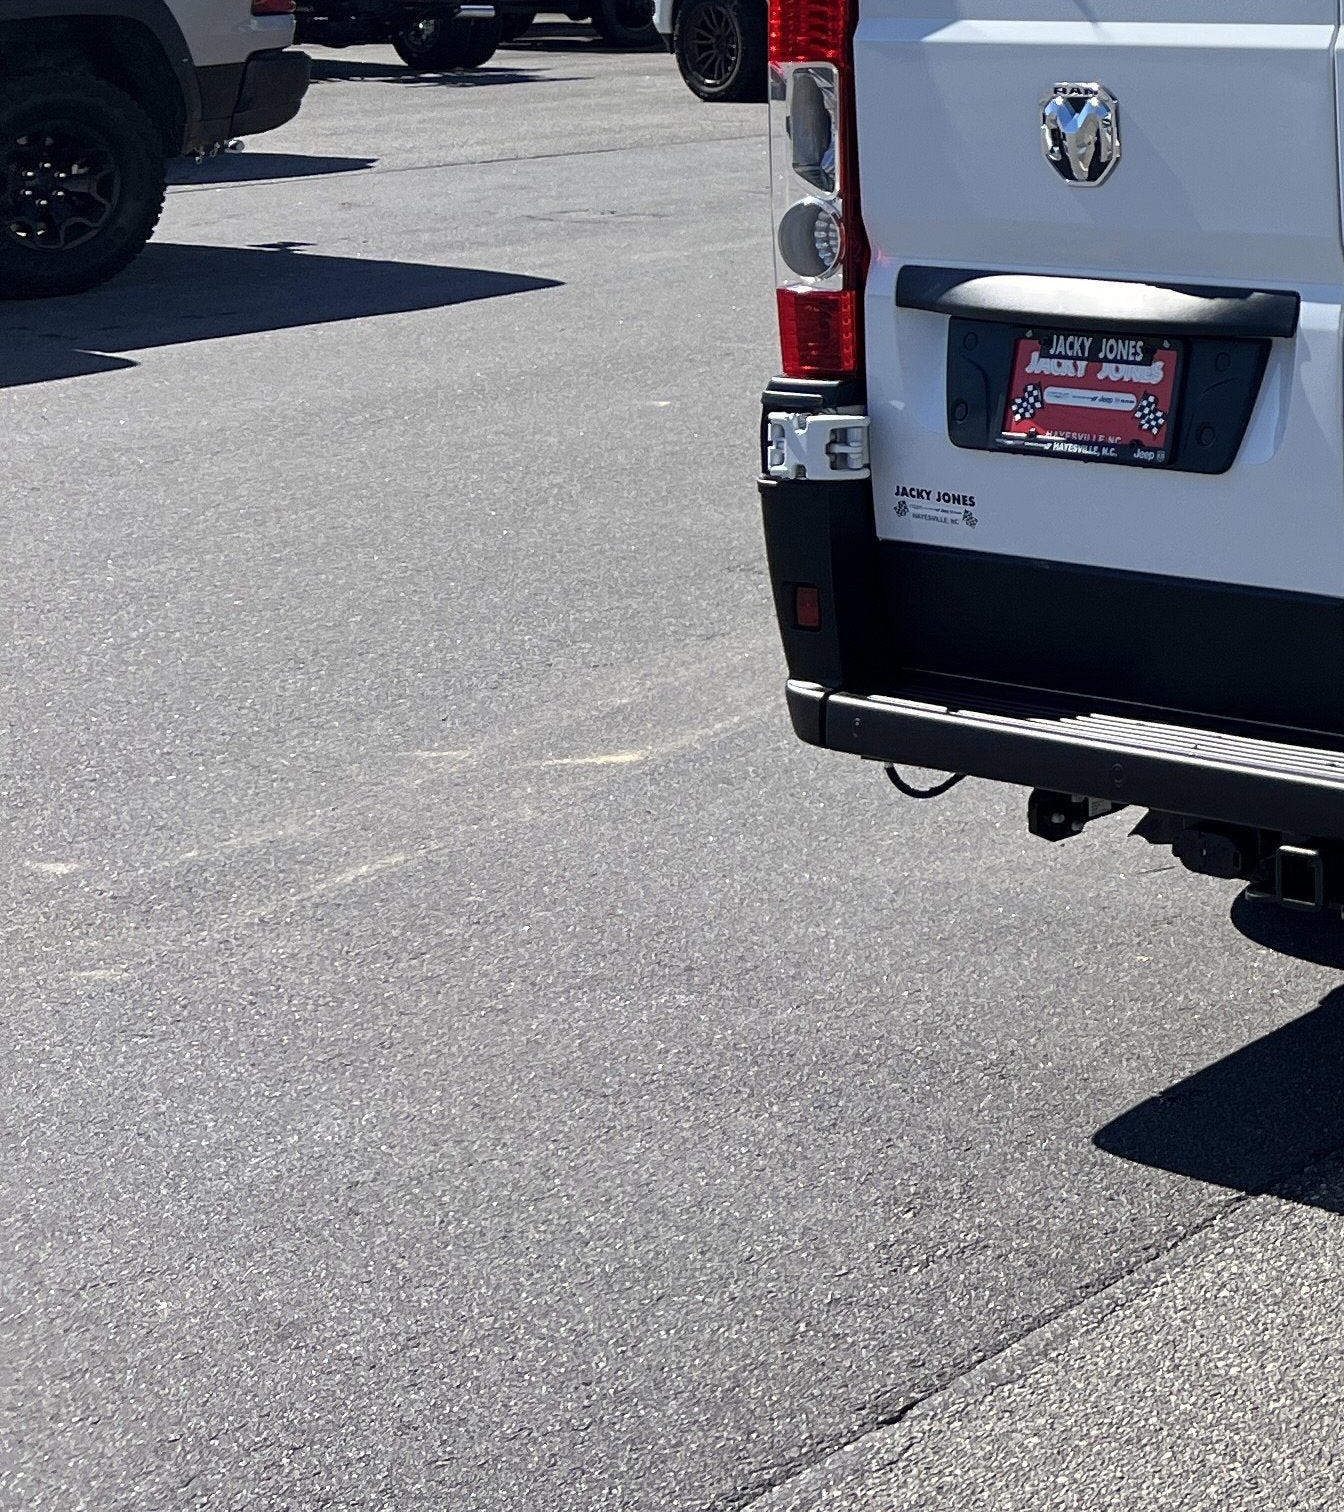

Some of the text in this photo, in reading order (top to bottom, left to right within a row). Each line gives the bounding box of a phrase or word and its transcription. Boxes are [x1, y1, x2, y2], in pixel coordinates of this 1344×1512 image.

[1053, 85, 1099, 96] RAM
[1049, 334, 1144, 362] JACKY JONES
[1133, 448, 1155, 461] Jeep
[895, 486, 976, 507] JACKY JONES
